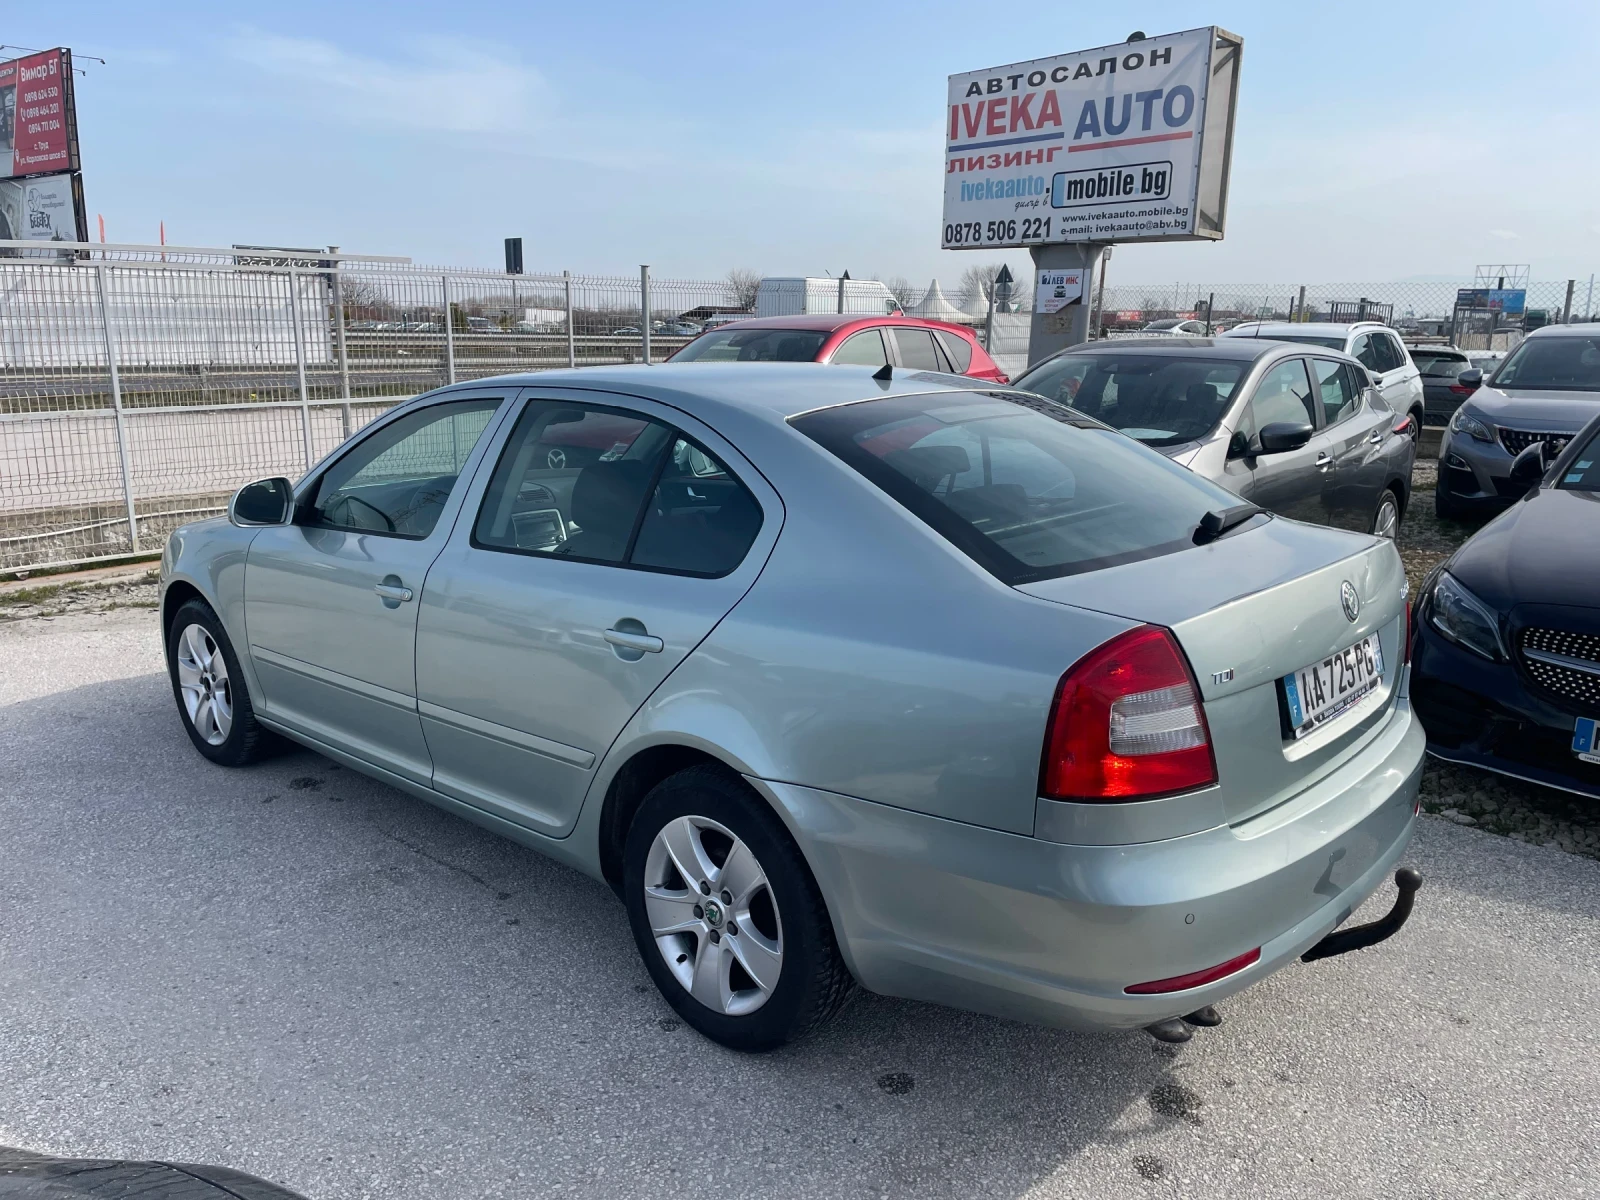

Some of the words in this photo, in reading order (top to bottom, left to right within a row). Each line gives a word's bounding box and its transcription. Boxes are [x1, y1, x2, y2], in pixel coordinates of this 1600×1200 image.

[20, 64, 48, 82] Вимар
[48, 58, 58, 75] БГ
[965, 47, 1172, 98] АВТОСАЛОН
[950, 89, 1063, 141] IVEKA
[1072, 84, 1196, 141] AUTO
[947, 145, 1064, 174] ЛИЗИНГ
[1060, 225, 1093, 235] e-mail:
[1095, 218, 1187, 233] ivekaauto@abv.bg
[1061, 205, 1189, 223] www.ivekaauto.mobile.bg
[944, 221, 982, 244] 0878
[986, 218, 1017, 242] 506
[1021, 216, 1052, 240] 221
